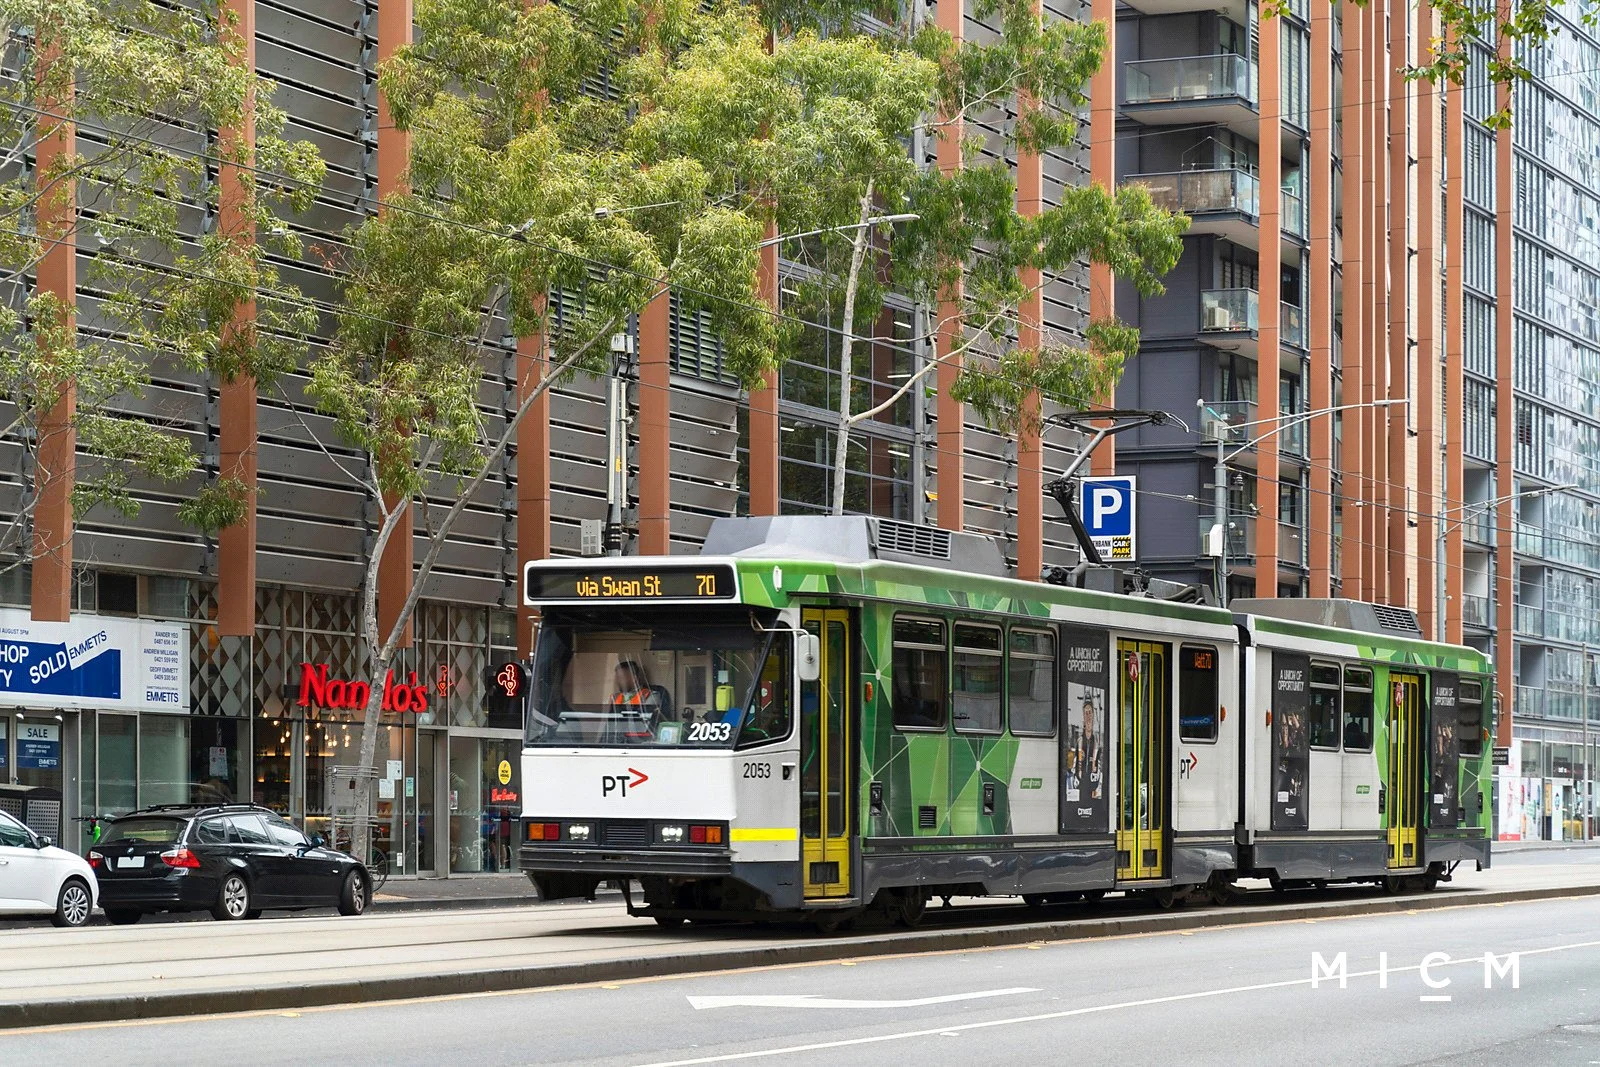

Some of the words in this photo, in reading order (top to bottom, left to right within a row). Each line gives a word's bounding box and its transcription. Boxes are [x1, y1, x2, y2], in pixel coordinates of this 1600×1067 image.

[1093, 488, 1122, 529] P
[576, 576, 599, 597] via
[602, 576, 641, 597] Swan
[644, 575, 662, 596] St
[695, 575, 716, 596] 70
[69, 630, 107, 660] EMMETTS
[1070, 647, 1075, 659] A
[1075, 647, 1092, 660] UNION
[1092, 648, 1100, 660] OF
[29, 650, 67, 685] SOLD
[1067, 659, 1103, 673] OPPORTUNITY
[1279, 669, 1284, 680] A
[1284, 669, 1296, 680] UNION
[1296, 670, 1303, 681] OF
[1277, 680, 1305, 692] OPPORTUNITY
[146, 691, 179, 703] EMMETTS
[27, 728, 48, 738] SALE
[687, 722, 732, 741] 2053
[743, 762, 771, 779] 2053
